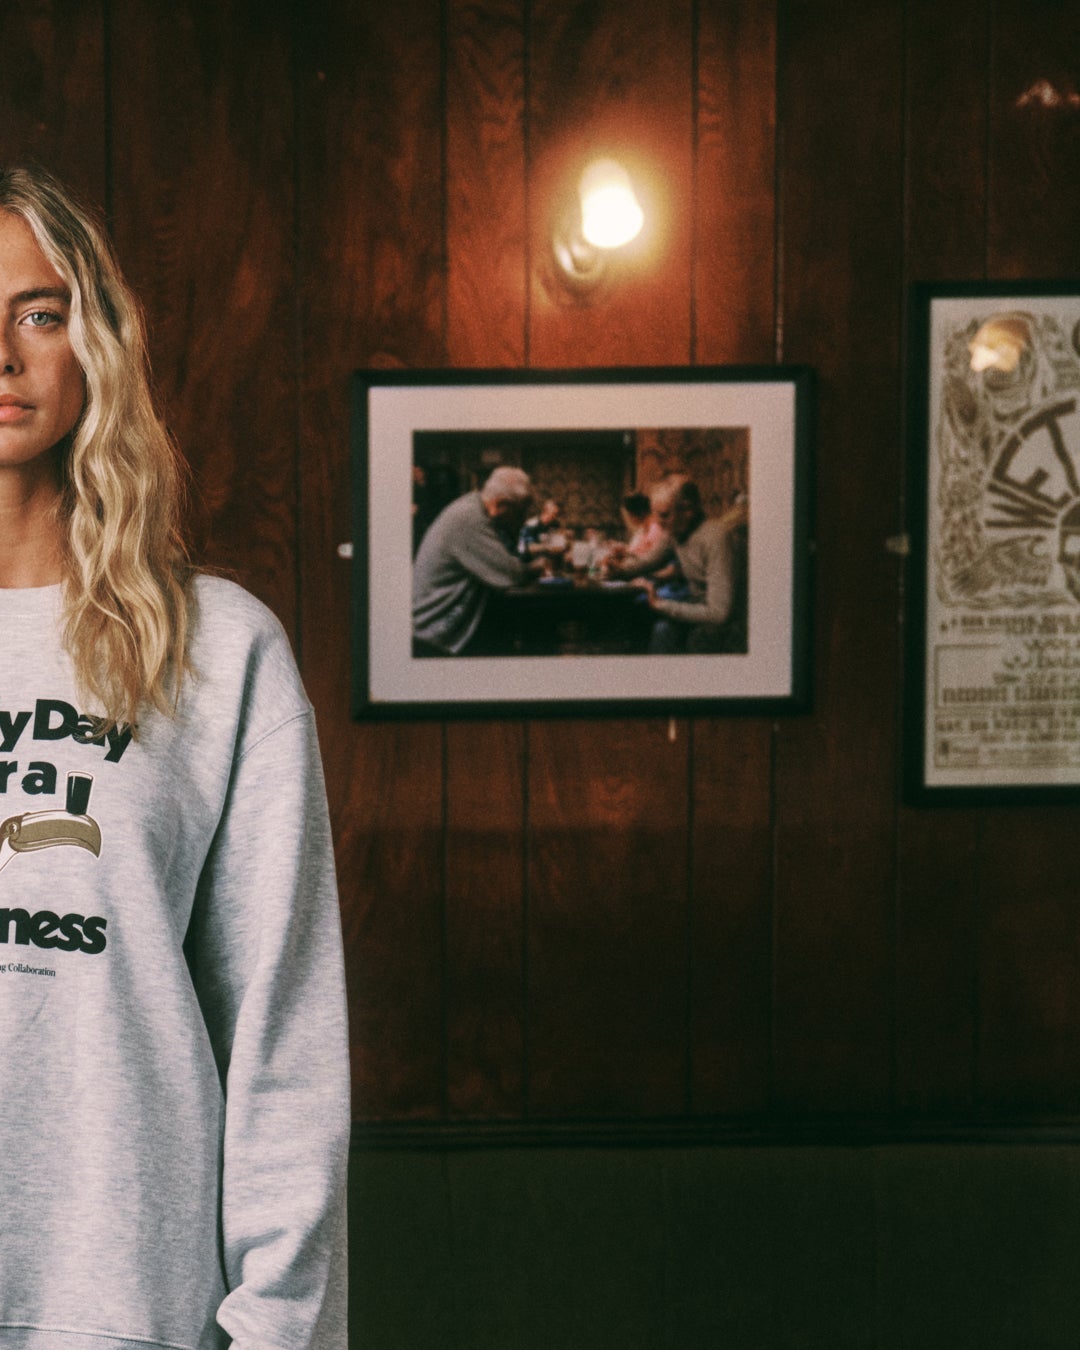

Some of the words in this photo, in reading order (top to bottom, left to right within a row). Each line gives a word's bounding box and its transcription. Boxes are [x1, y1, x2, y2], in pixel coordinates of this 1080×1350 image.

[32, 698, 139, 763] Day
[21, 761, 57, 795] a
[8, 963, 56, 977] Collaboration
